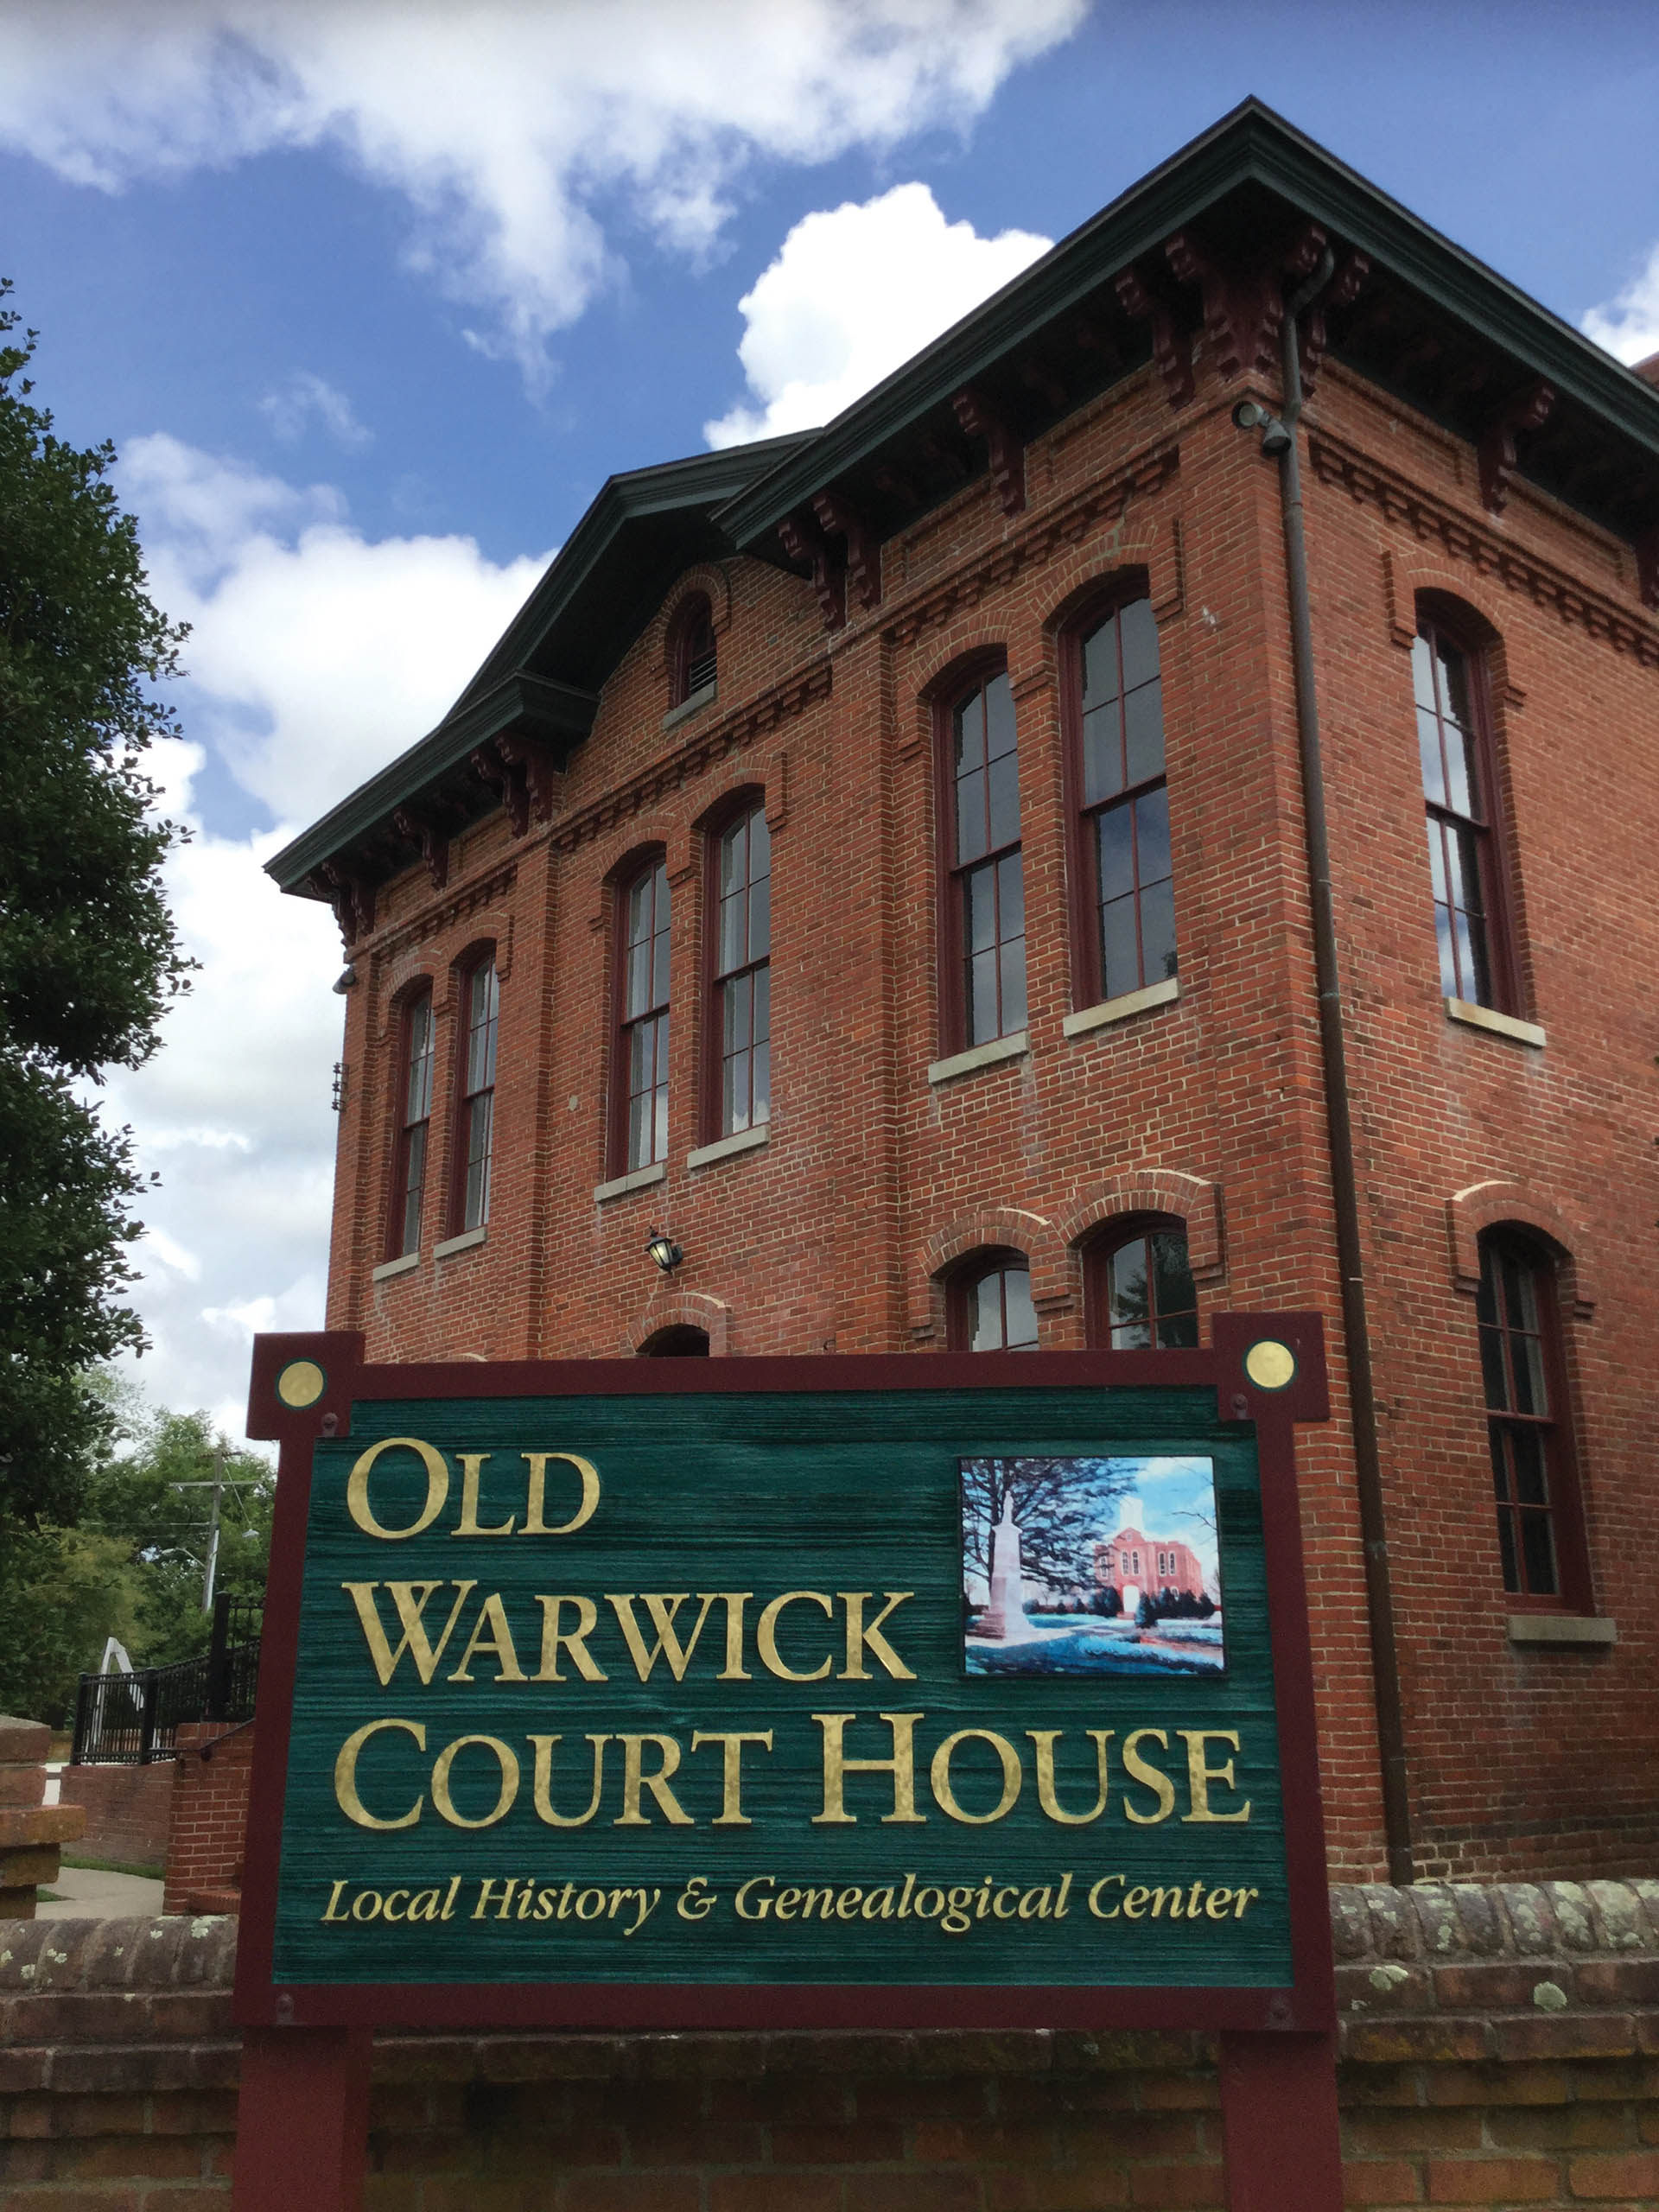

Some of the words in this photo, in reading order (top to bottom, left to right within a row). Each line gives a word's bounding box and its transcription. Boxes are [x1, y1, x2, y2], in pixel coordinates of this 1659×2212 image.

[346, 1436, 601, 1540] OLD
[341, 1579, 917, 1686] WARWICK
[334, 1718, 773, 1829] COURT
[810, 1712, 1251, 1825] HOUSE
[320, 1875, 461, 1923] Local
[468, 1877, 662, 1936] History
[677, 1876, 717, 1921] &
[734, 1872, 1073, 1933] Genealogical
[1088, 1873, 1260, 1920] Center
